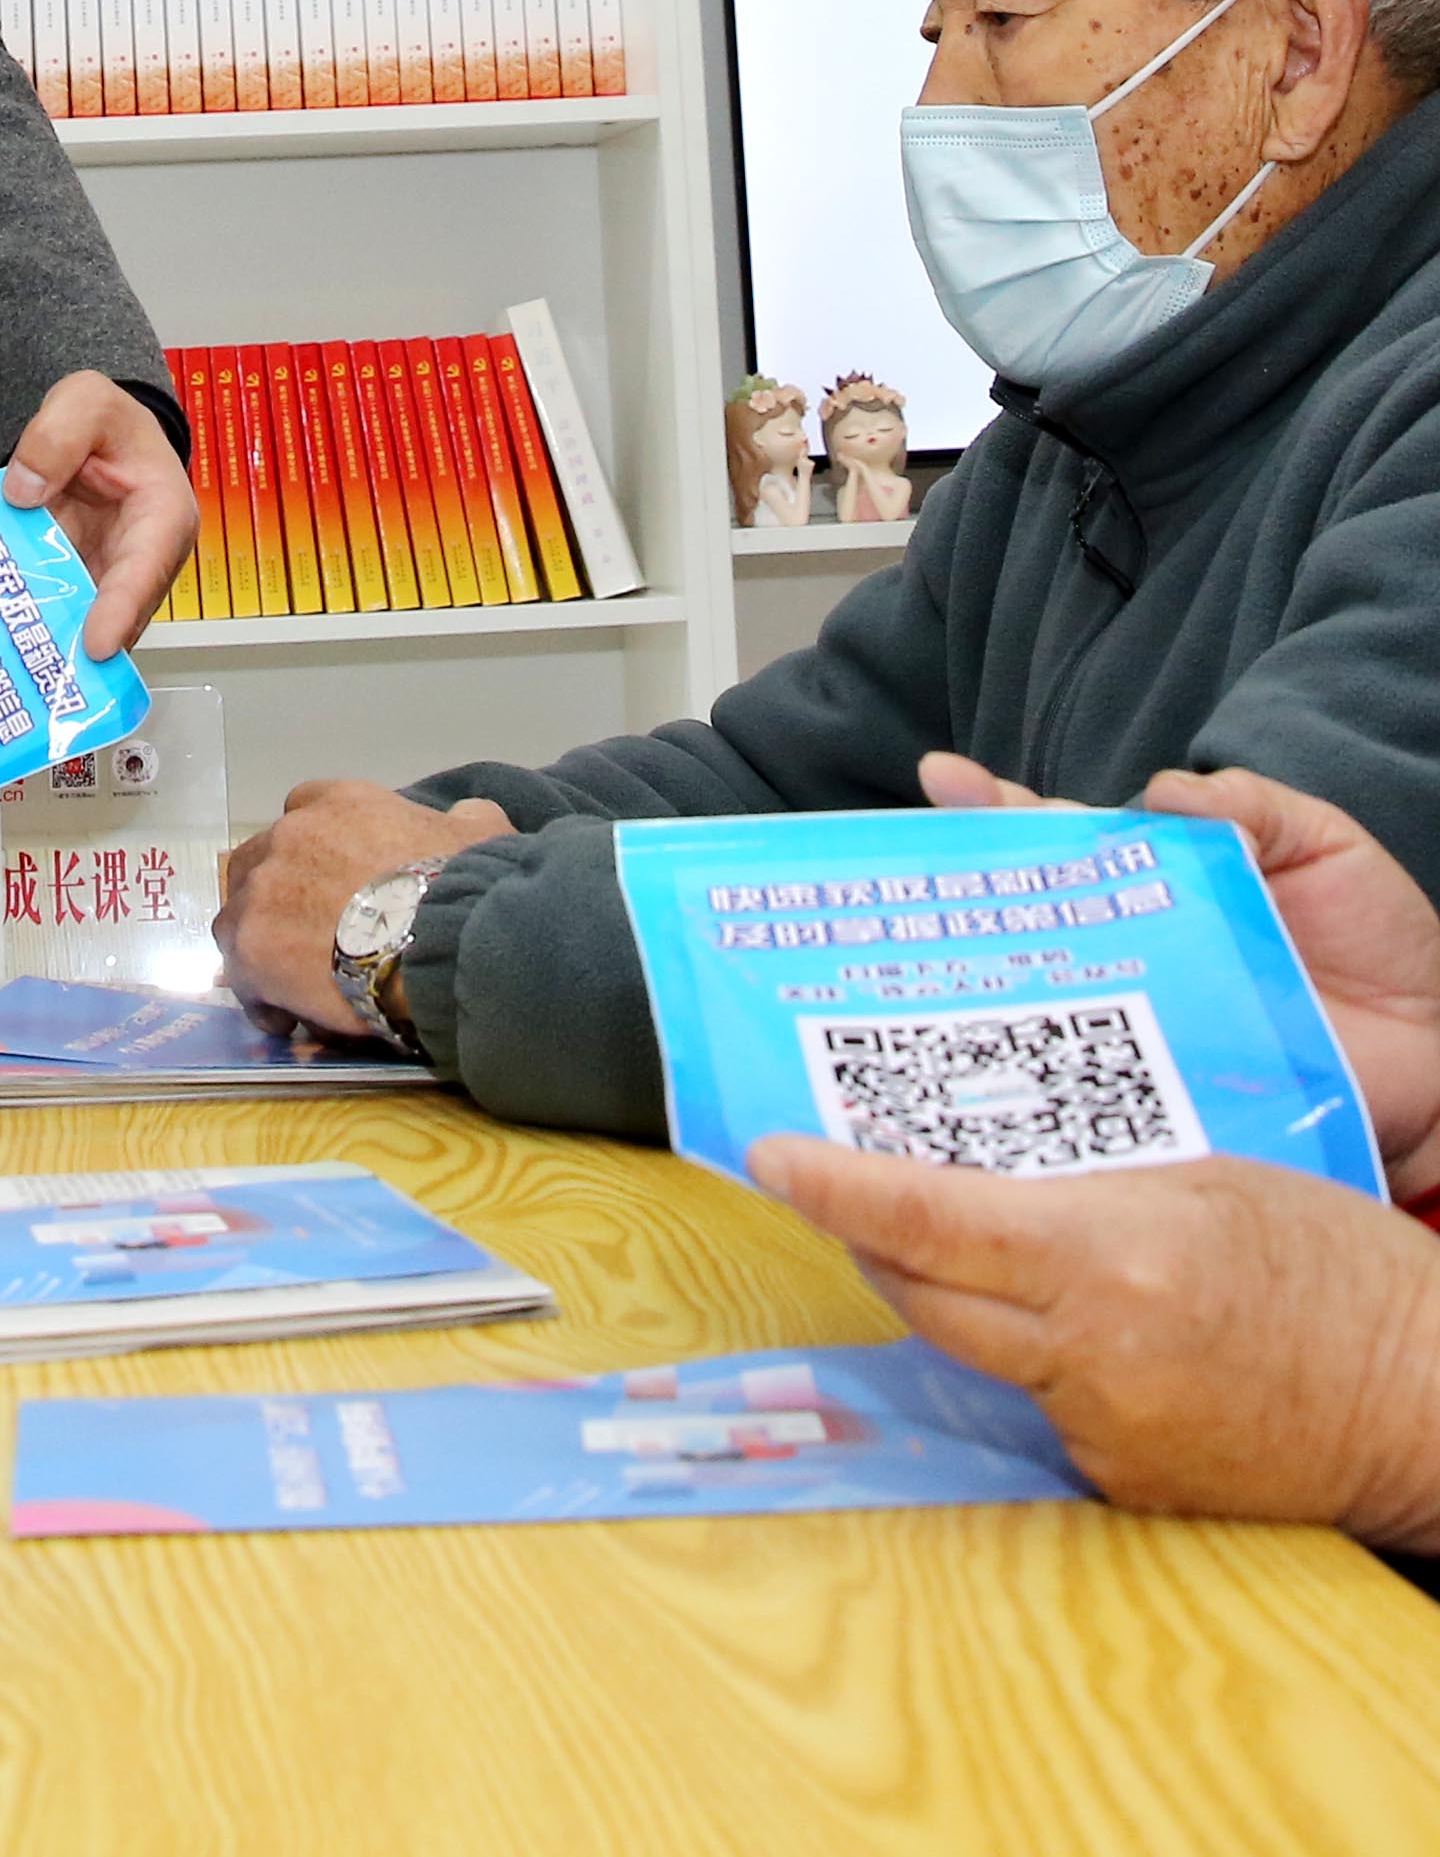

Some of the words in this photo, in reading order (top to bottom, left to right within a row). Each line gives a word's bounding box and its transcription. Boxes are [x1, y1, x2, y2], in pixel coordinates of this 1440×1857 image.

[710, 840, 1157, 913] 快速获取最新资讯
[718, 880, 1173, 949] 及时掌握政策信息
